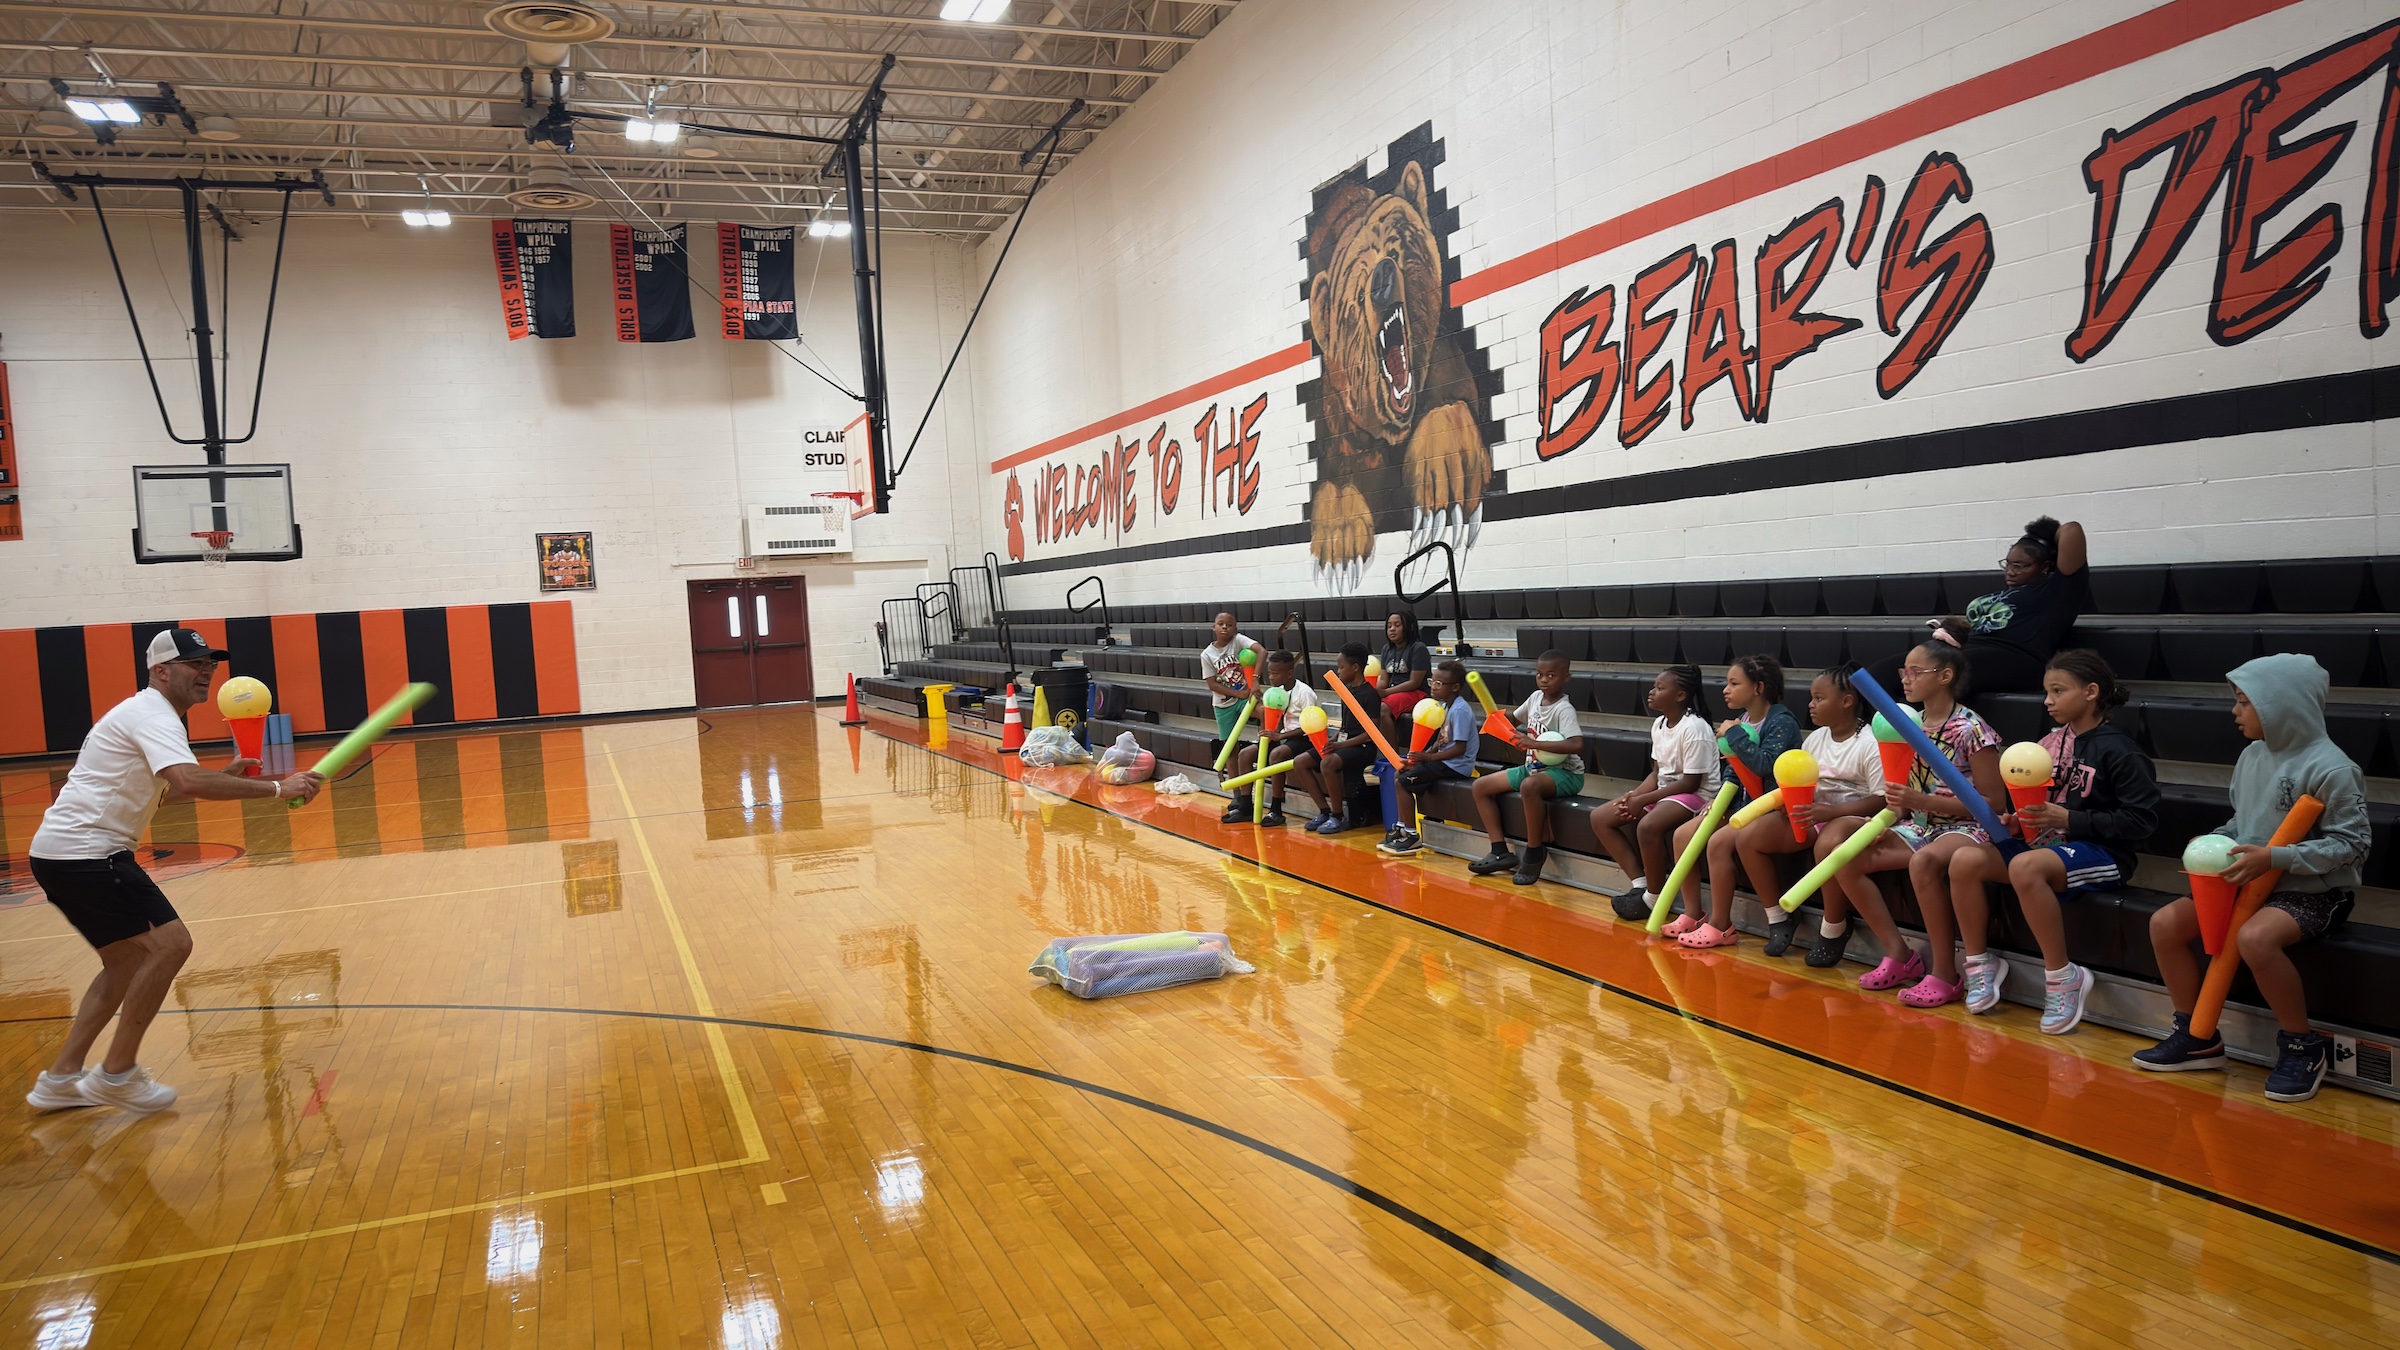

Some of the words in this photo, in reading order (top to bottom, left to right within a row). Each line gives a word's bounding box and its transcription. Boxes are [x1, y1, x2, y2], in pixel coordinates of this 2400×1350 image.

[514, 222, 568, 234] CHAMPIONSHIPS
[741, 228, 792, 240] CHAMPIONSHIPS
[527, 235, 556, 246] WPIAL
[753, 240, 780, 252] WPIAL
[647, 243, 675, 255] WPIAL
[496, 232, 518, 290] SWIMMING
[518, 256, 533, 264] 947
[534, 256, 551, 264] 1957
[614, 228, 633, 300] BASKETBALL
[634, 254, 652, 262] 2001
[721, 227, 738, 299] BASKETBALL
[634, 262, 653, 271] 2002
[743, 301, 765, 313] PIAA
[766, 301, 794, 313] STATE
[1535, 150, 1994, 461] BEAR'S
[507, 299, 525, 328] BOYS
[743, 313, 760, 321] 1991
[620, 307, 636, 341] GIRLS
[725, 307, 740, 335] BOYS
[1034, 435, 1140, 547] WELCOME
[1148, 421, 1182, 528] TO
[1194, 392, 1268, 520] THE
[739, 557, 752, 567] EXIT
[2288, 1043, 2304, 1051] FILA
